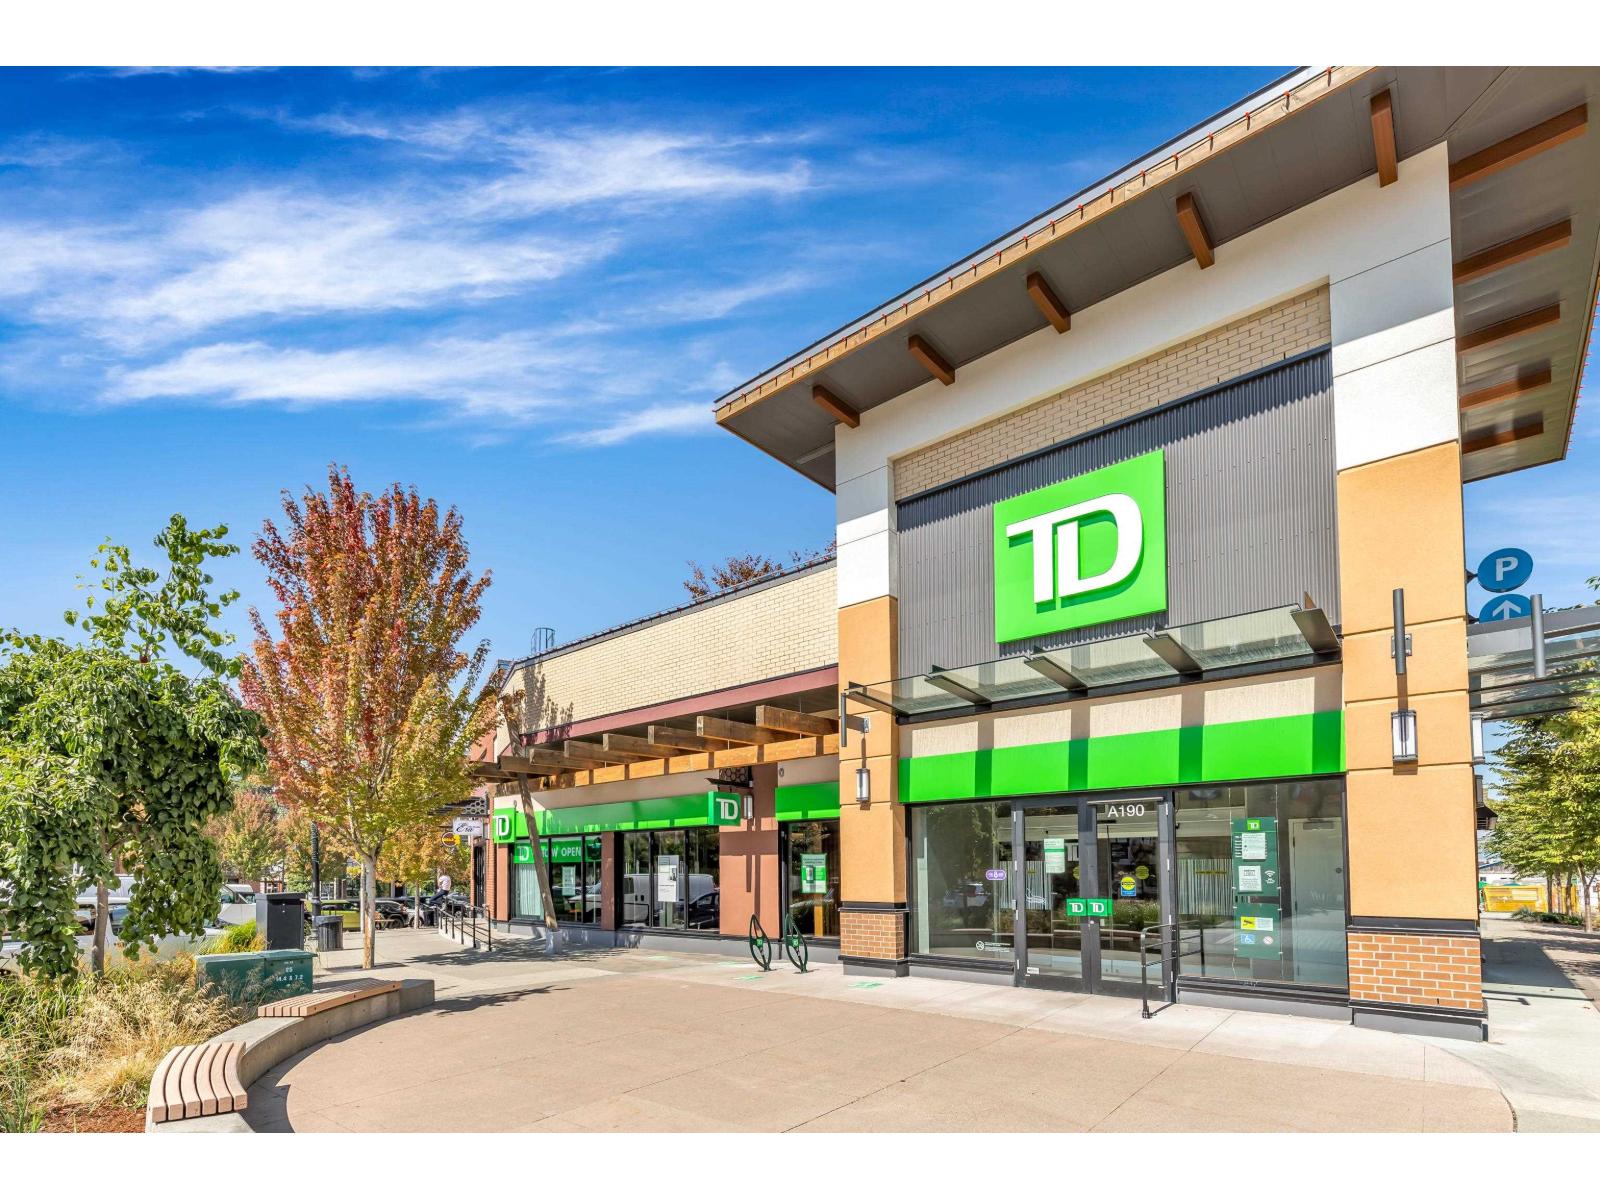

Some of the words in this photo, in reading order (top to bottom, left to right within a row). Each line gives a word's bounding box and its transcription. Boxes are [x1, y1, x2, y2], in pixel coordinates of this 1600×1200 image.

[1006, 493, 1143, 604] TD
[1495, 556, 1518, 581] P
[716, 797, 739, 819] TD
[1107, 804, 1145, 818] A190
[492, 814, 510, 836] TD
[561, 846, 581, 857] OPEN
[1068, 902, 1084, 913] TD
[1090, 902, 1105, 913] TD
